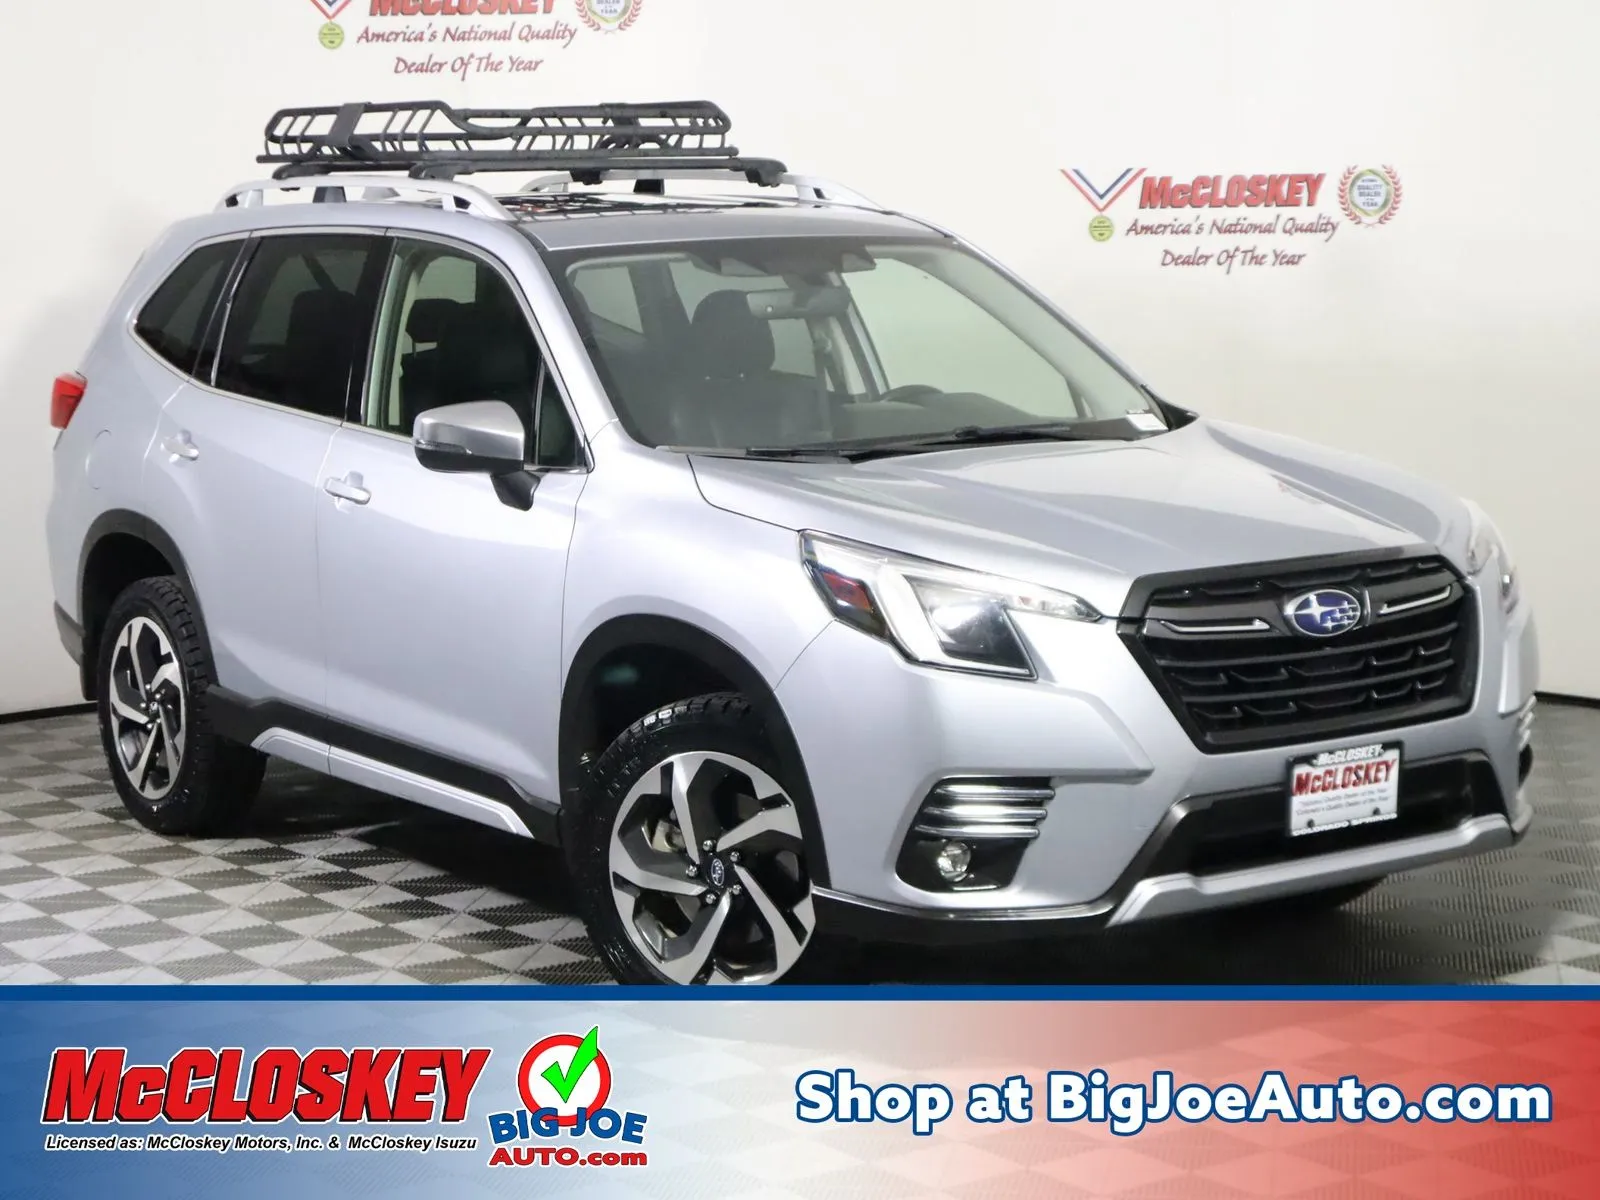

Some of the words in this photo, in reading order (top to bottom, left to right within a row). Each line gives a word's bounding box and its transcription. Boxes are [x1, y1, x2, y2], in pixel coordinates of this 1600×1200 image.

[356, 22, 438, 44] America's
[442, 22, 513, 43] National
[516, 23, 577, 49] Quality
[393, 54, 447, 75] Dealer
[450, 53, 474, 82] Of
[474, 54, 504, 73] The
[508, 55, 544, 73] Year
[1138, 173, 1327, 209] McCLOSKEY
[1125, 215, 1205, 237] America's
[1208, 213, 1278, 236] National
[1281, 213, 1340, 243] Quality
[1160, 248, 1213, 268] Dealer
[1217, 247, 1241, 275] Of
[1241, 248, 1269, 267] The
[1272, 248, 1306, 267] Year
[1292, 758, 1397, 797] McCLOSKEY
